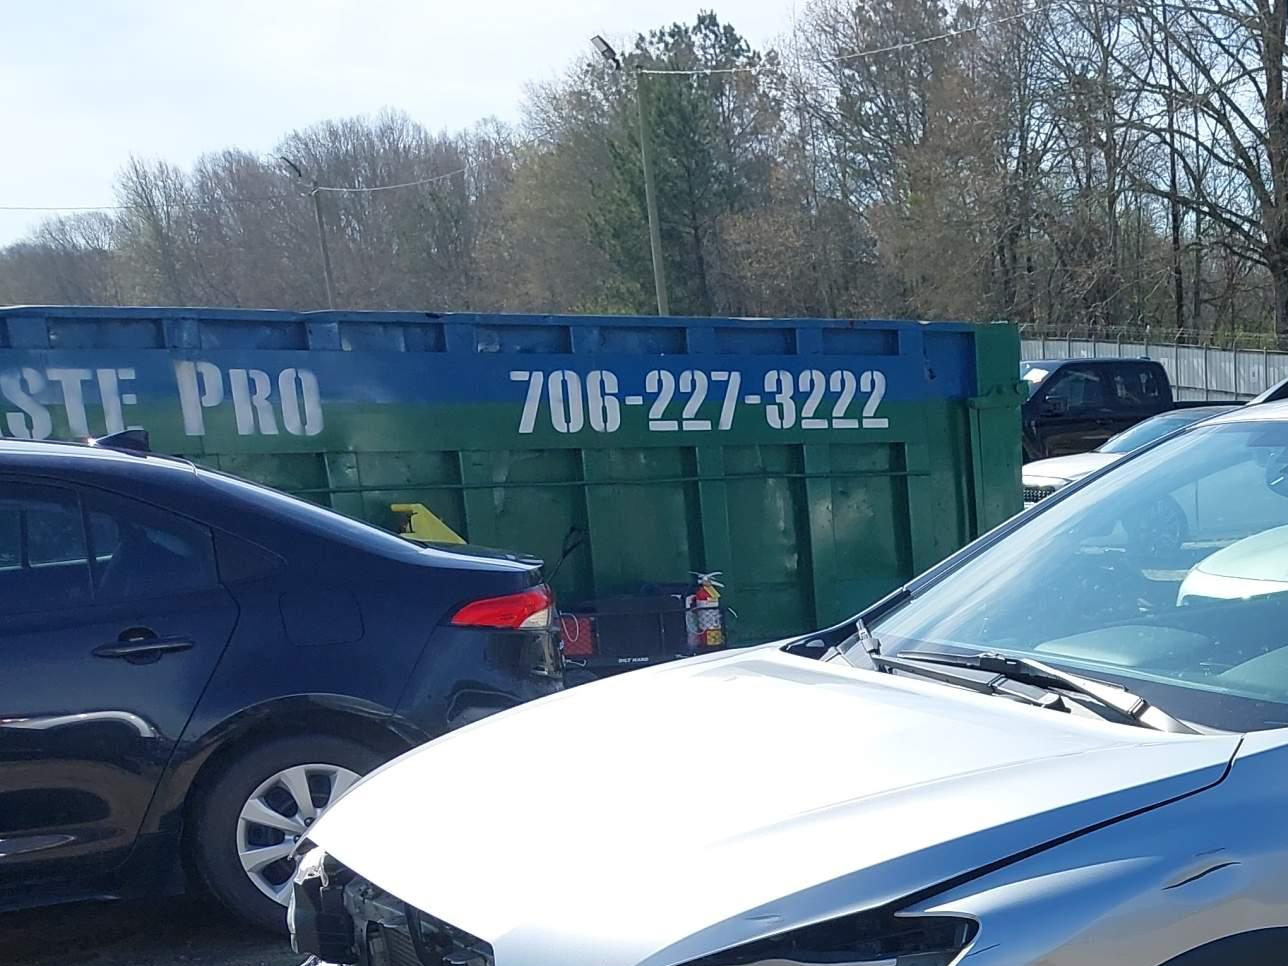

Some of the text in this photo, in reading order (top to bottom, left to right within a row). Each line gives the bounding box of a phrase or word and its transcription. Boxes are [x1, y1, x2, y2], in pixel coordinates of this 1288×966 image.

[0, 360, 325, 439] STE PRO
[510, 369, 889, 434] 706-227-3222
